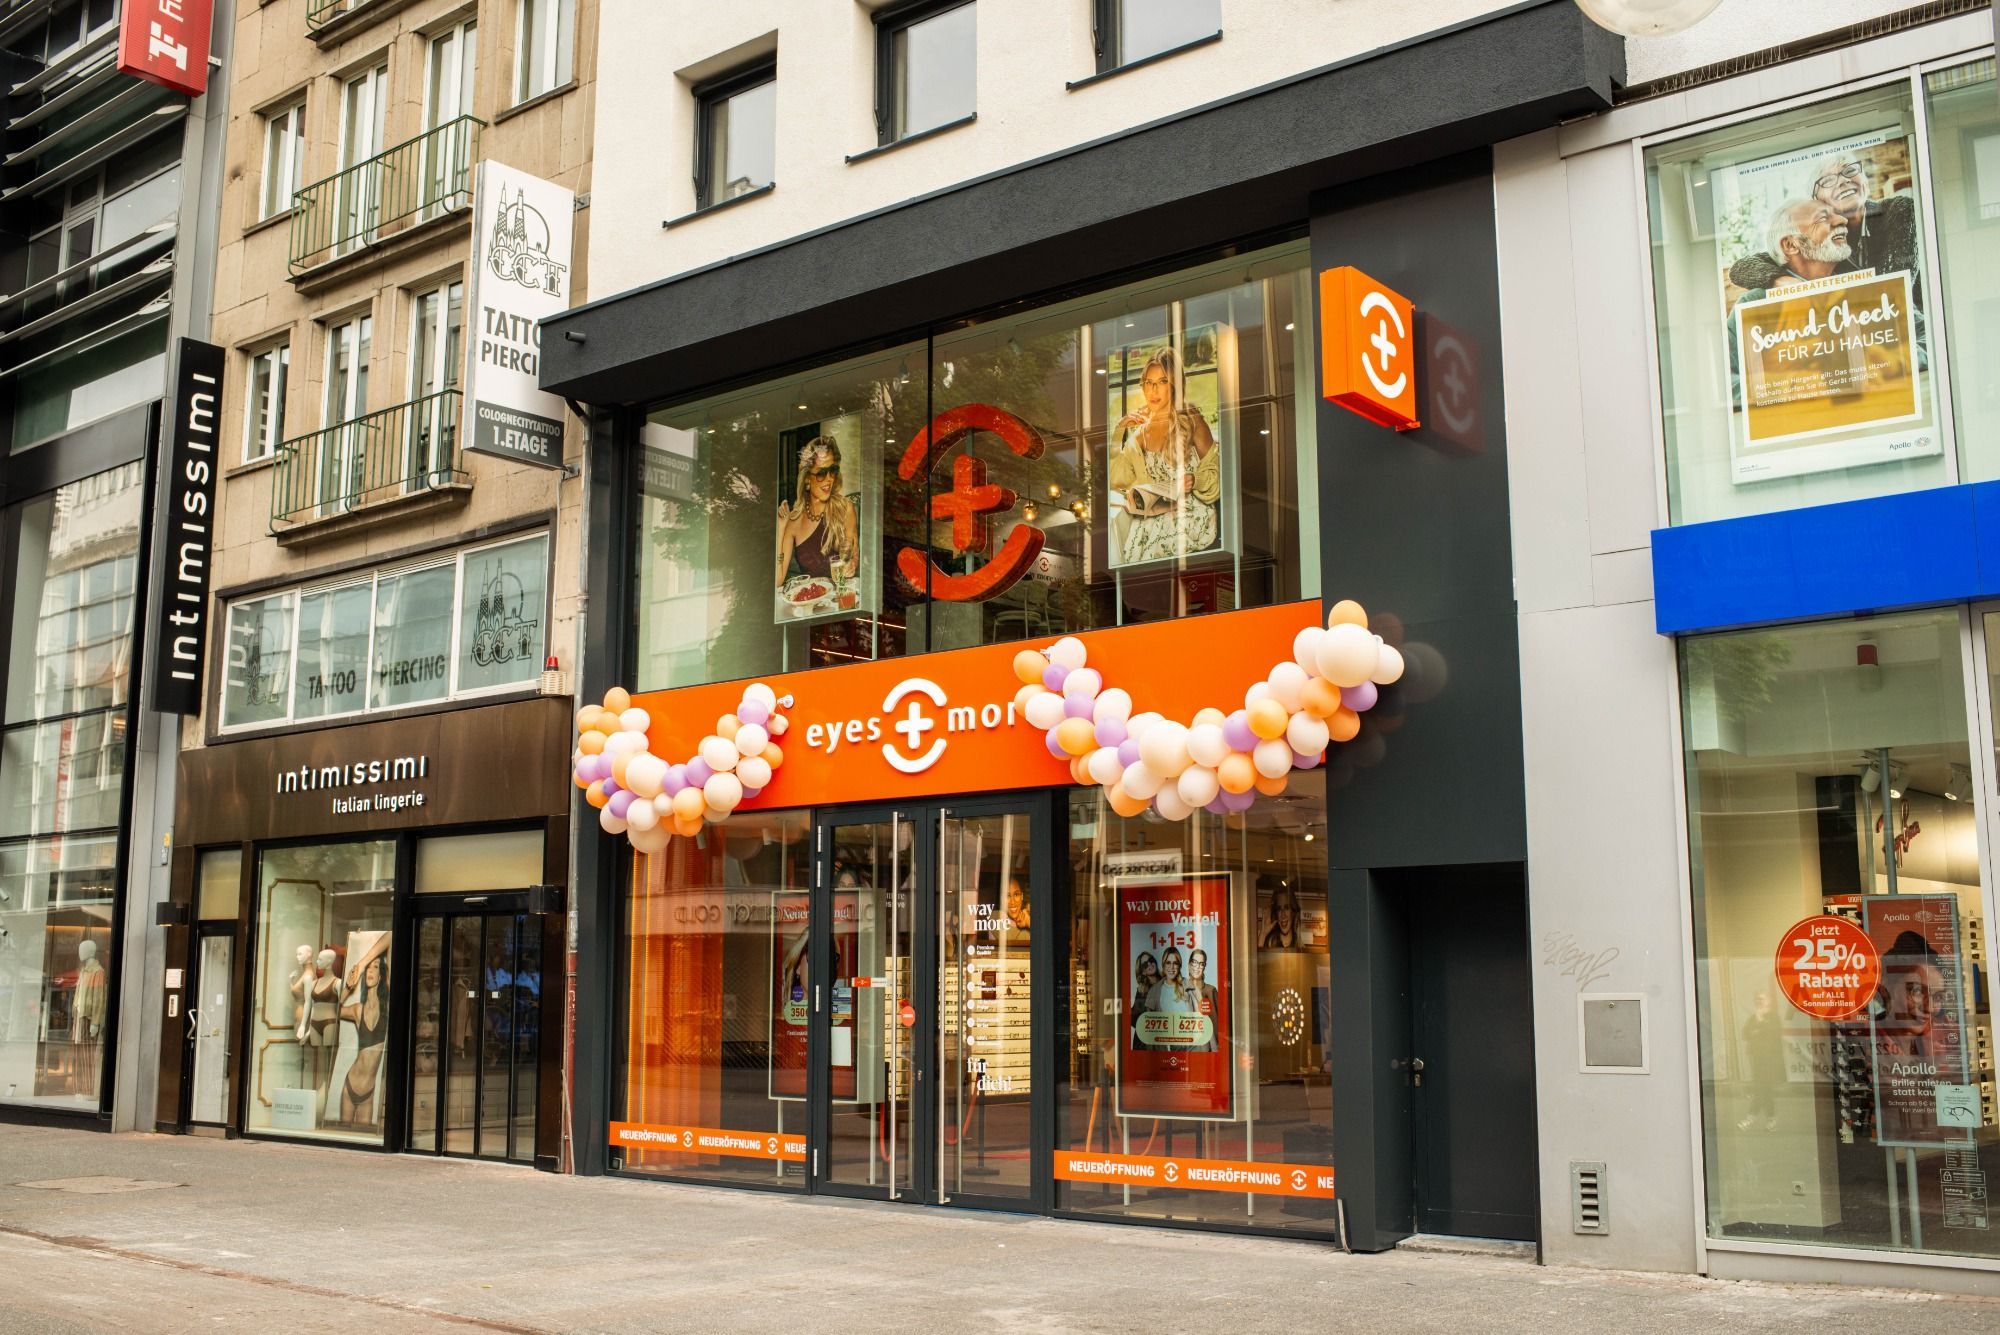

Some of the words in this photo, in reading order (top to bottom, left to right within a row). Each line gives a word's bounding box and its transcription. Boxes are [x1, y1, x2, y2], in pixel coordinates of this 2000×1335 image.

[1842, 142, 1862, 150] ETWAS
[1768, 270, 1873, 298] HÖRGERÄTETECHNIK
[483, 306, 541, 350] TATT
[1750, 292, 1900, 353] Sound-Check
[1778, 342, 1809, 363] FÜR
[1812, 340, 1835, 357] ZU
[1840, 328, 1899, 351] HAUSE.
[481, 340, 537, 376] PIERCI
[1834, 369, 1848, 377] Das
[1828, 377, 1847, 386] Gerät
[478, 406, 561, 437] COLOGNECITYTATTOO
[1889, 437, 1911, 450] Apollo
[806, 716, 882, 754] eyes
[947, 701, 1017, 732] mor
[332, 796, 371, 815] Italian
[374, 790, 424, 813] lingerie
[968, 903, 995, 920] way
[1126, 900, 1152, 915] way
[1155, 899, 1191, 912] more
[974, 918, 1011, 931] more
[1170, 911, 1220, 928] Vorteil
[1883, 913, 1910, 923] Apollo
[1810, 924, 1840, 937] Jetzt
[1149, 930, 1196, 949] 1+1=3
[1793, 938, 1866, 971] 25%
[1799, 971, 1860, 988] Rabatt
[1813, 991, 1825, 999] auf
[1826, 991, 1845, 999] ALLE
[1144, 1019, 1169, 1030] 297€
[1178, 1019, 1204, 1030] 627€
[967, 1057, 989, 1073] für
[1891, 1062, 1937, 1077] Apollo
[976, 1075, 1012, 1091] dich!
[1891, 1079, 1916, 1087] Brille
[1917, 1079, 1952, 1087] mieten
[1893, 1088, 1916, 1096] statt
[1917, 1088, 1936, 1097] kau
[619, 1129, 677, 1143] NEUERÖFFNUNG
[699, 1135, 761, 1150] NEUERÖFFNUNG
[1069, 1159, 1155, 1177] NEUERÖFFNUNG
[1187, 1167, 1281, 1186] NEUERÖFFNUNG
